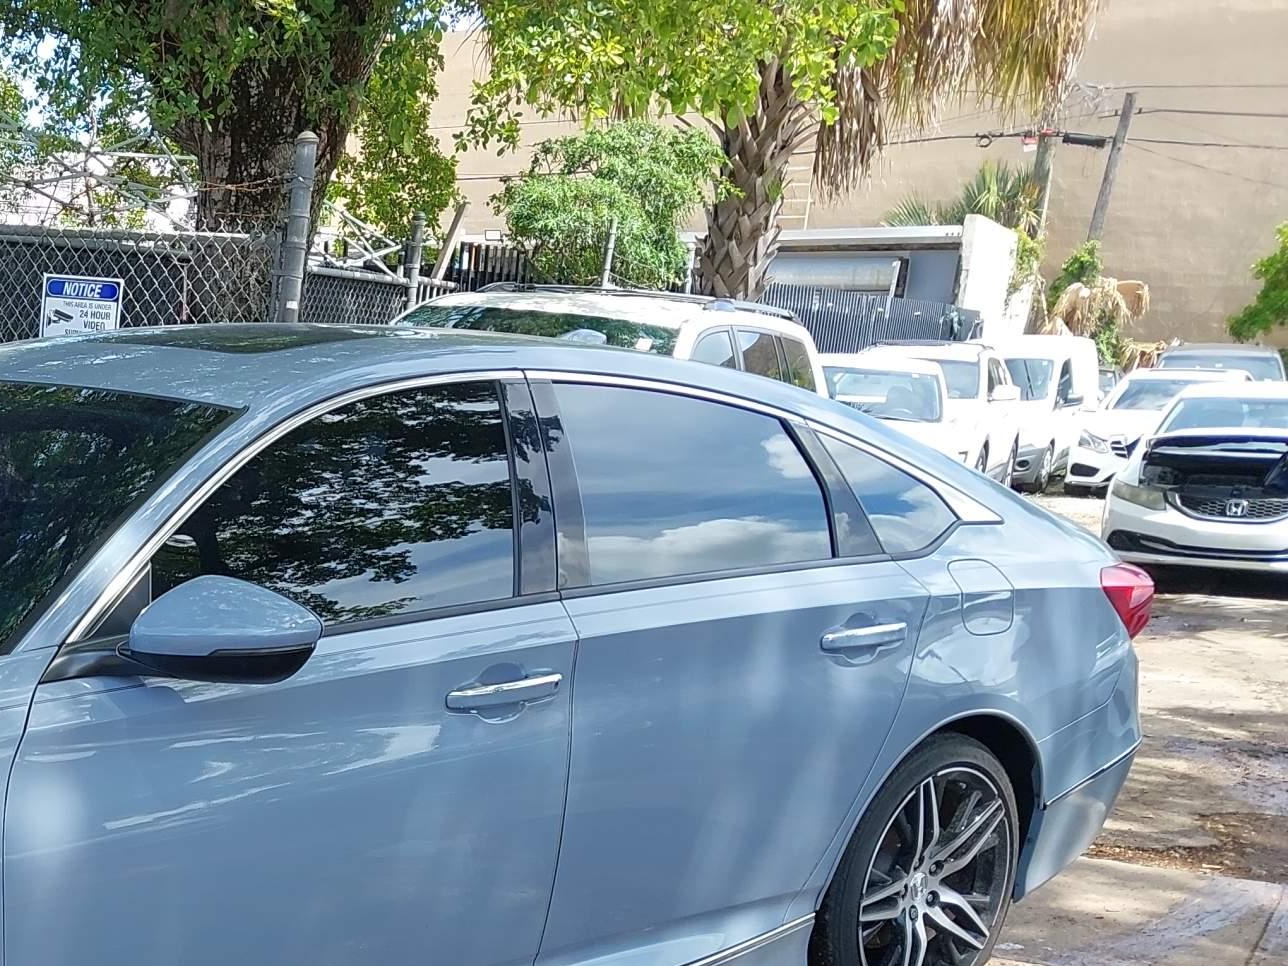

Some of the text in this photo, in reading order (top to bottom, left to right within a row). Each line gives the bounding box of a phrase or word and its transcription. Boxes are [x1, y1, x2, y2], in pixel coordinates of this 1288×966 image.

[63, 281, 103, 298] NOTICE
[74, 301, 88, 309] AREA
[94, 303, 112, 311] UNDER
[79, 309, 111, 321] 24 HOUR
[83, 320, 106, 331] VIDEO
